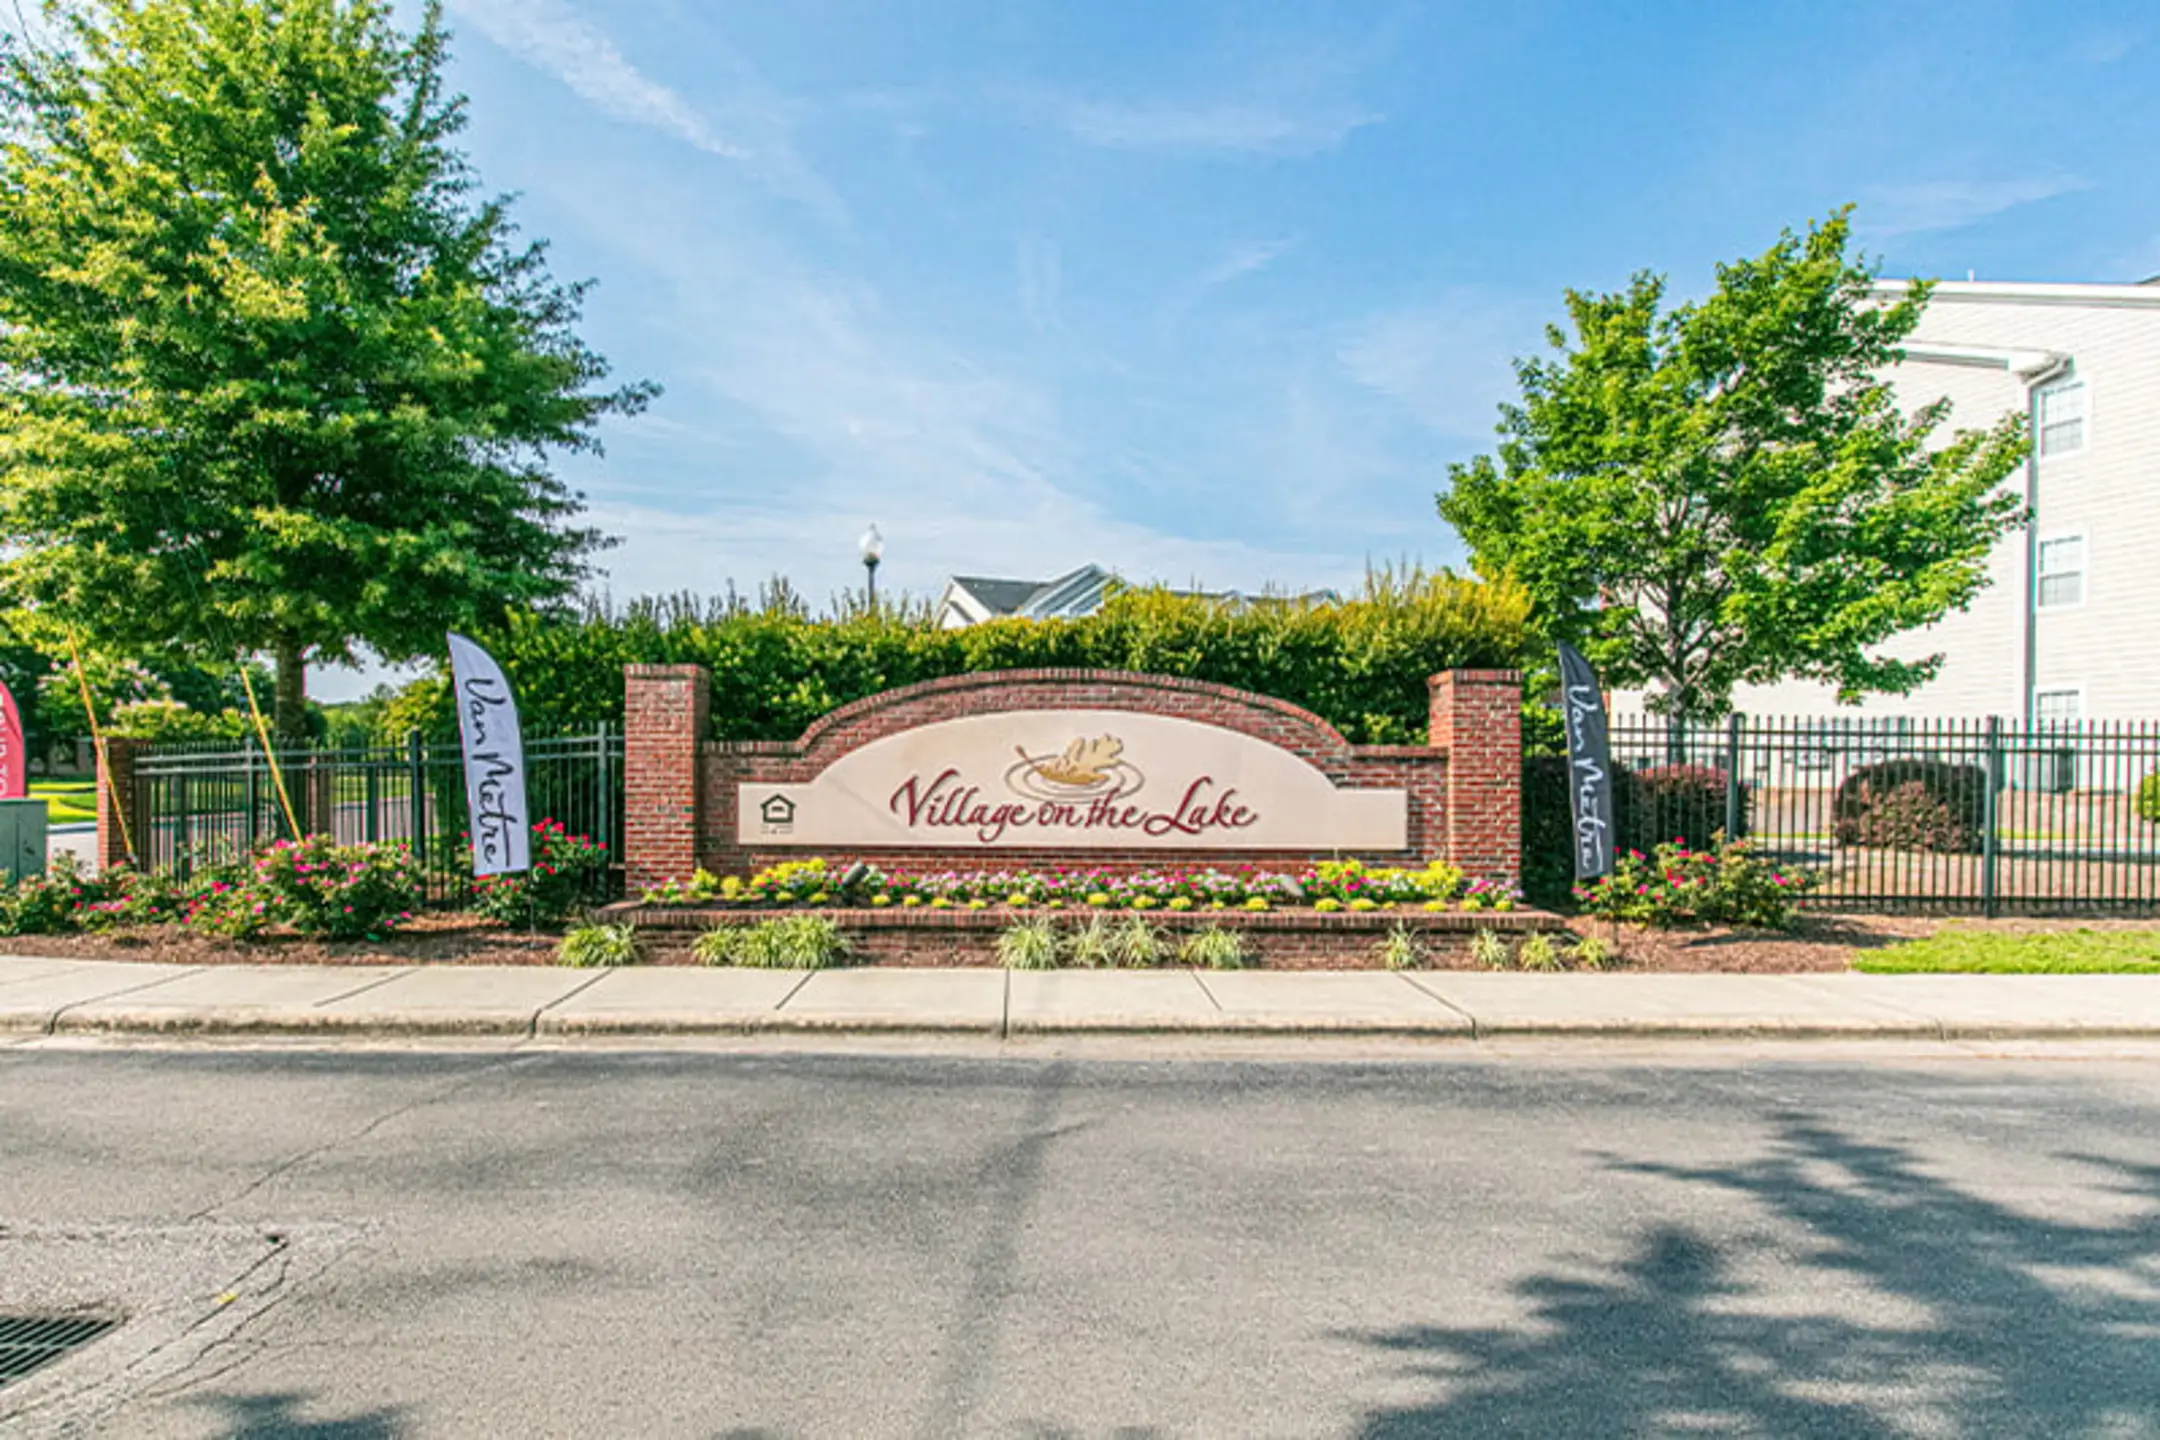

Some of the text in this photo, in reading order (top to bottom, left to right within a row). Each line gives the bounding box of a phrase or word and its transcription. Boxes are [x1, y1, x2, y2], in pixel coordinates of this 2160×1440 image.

[464, 678, 518, 867] Van Metre
[890, 768, 1259, 843] Village on the Lake
[1568, 684, 1606, 872] Van Metre
